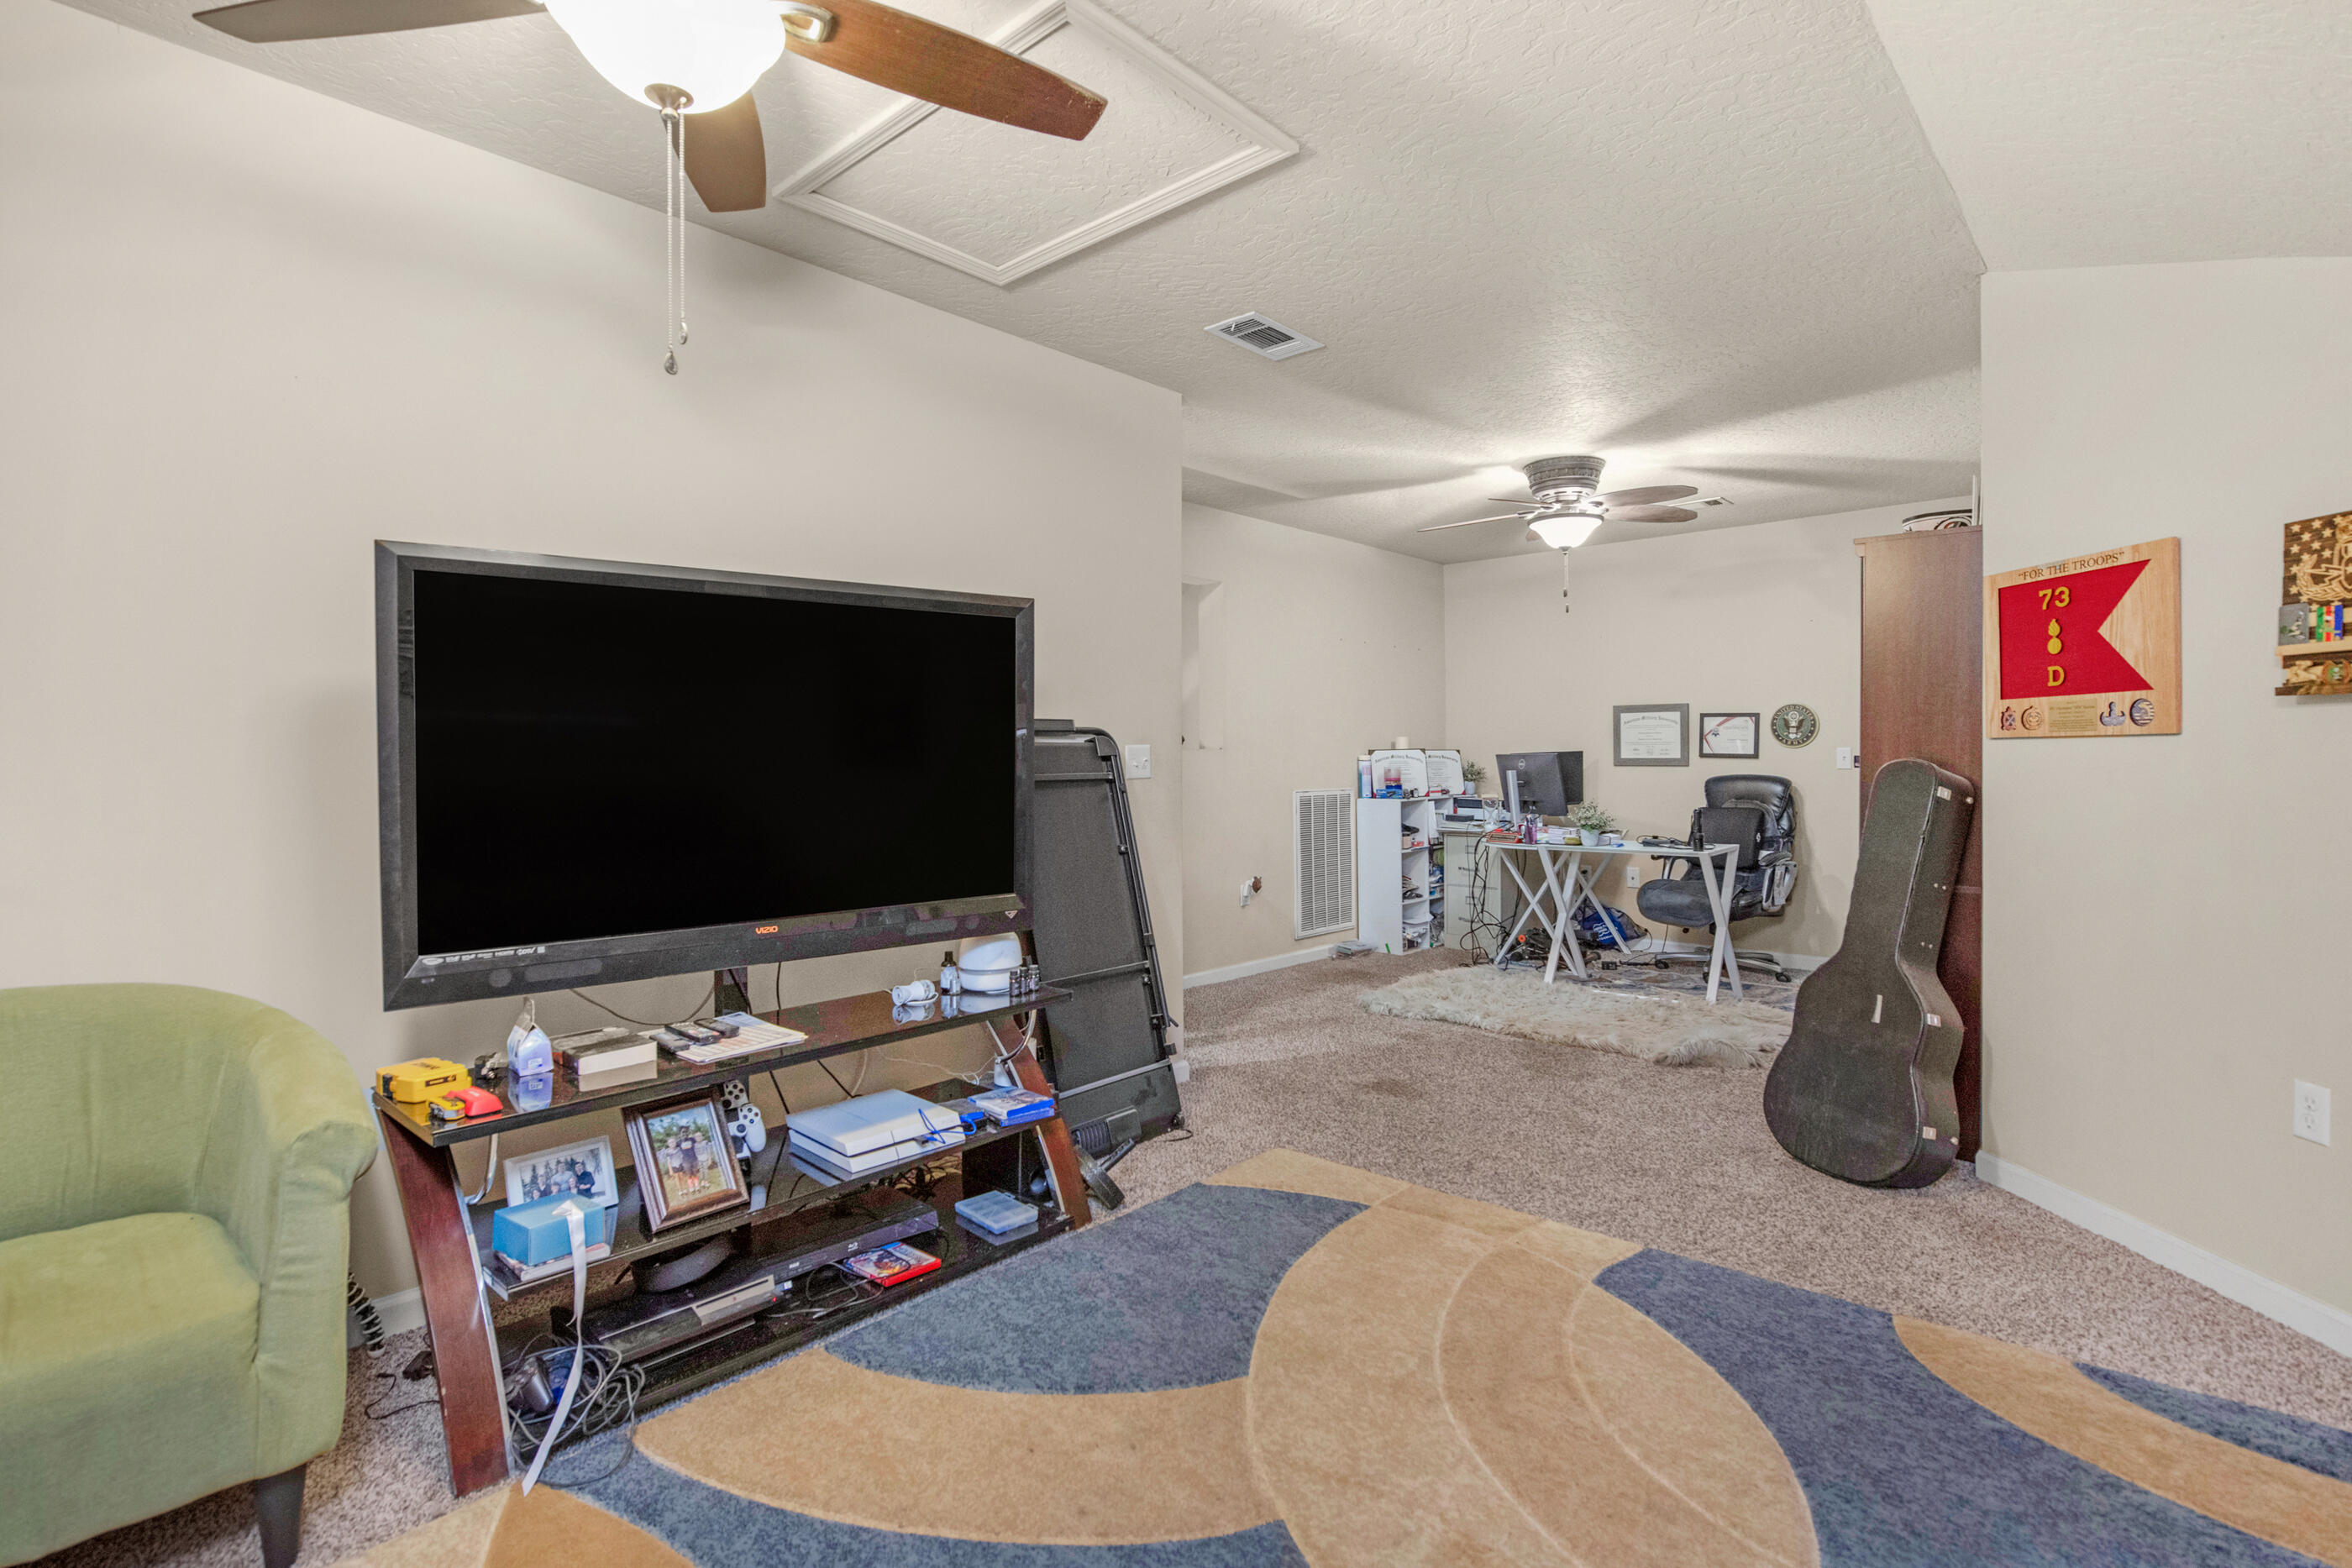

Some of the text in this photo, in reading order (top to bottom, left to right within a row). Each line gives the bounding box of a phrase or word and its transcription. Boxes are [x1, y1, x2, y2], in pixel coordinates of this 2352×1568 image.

[2047, 563, 2069, 576] THE
[2039, 586, 2071, 610] 73
[2047, 665, 2066, 687] D
[755, 926, 779, 934] VIZIO
